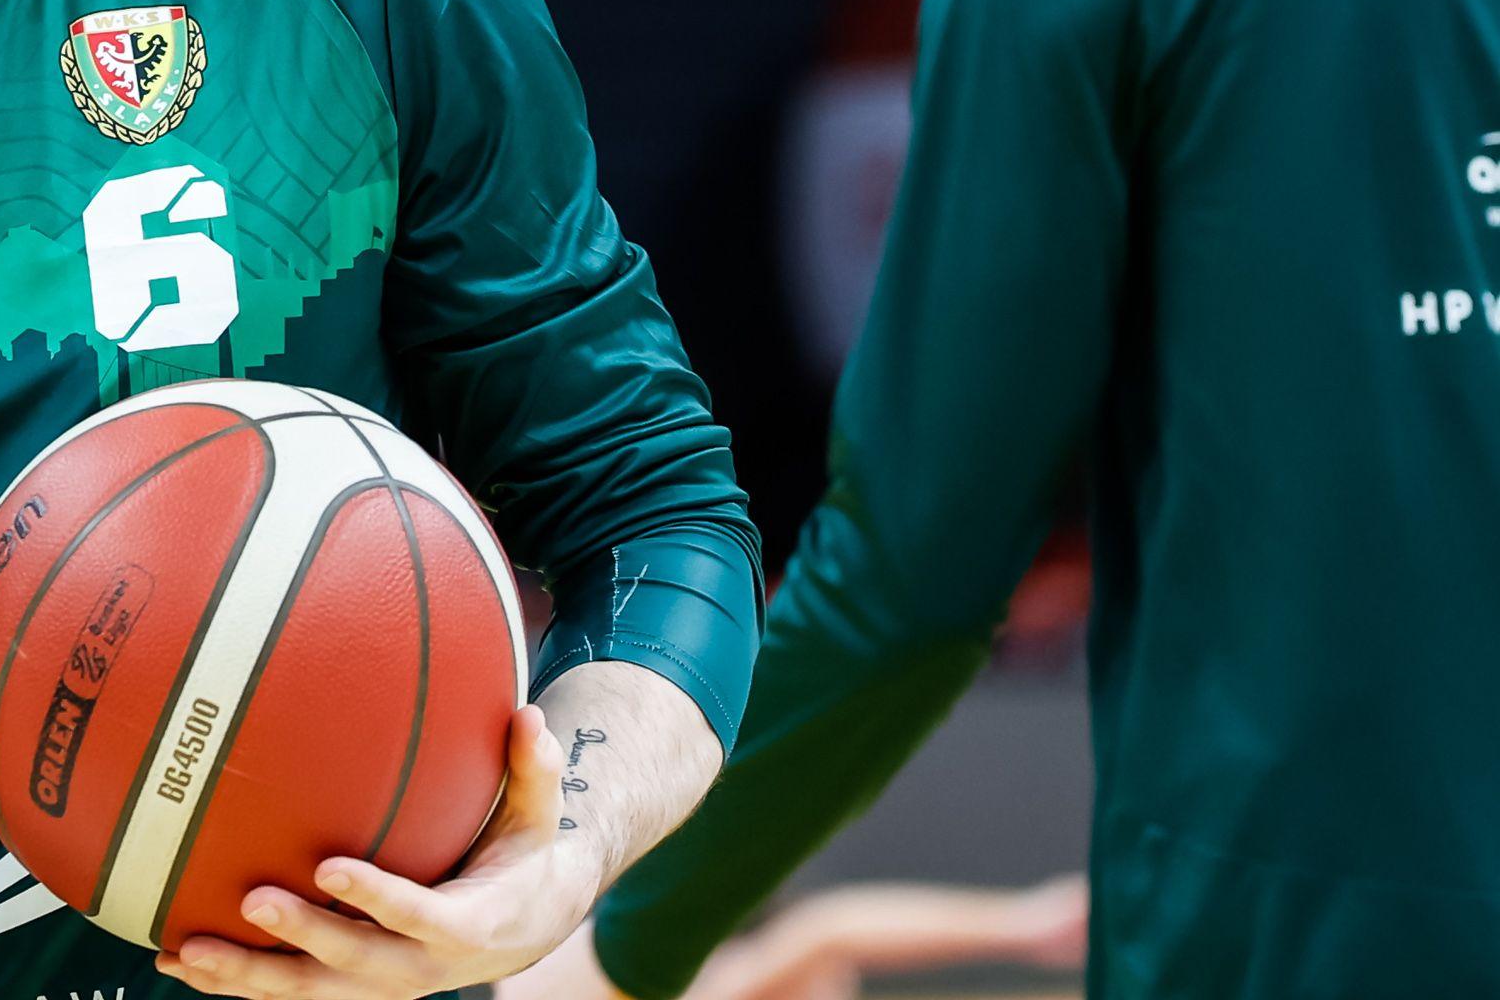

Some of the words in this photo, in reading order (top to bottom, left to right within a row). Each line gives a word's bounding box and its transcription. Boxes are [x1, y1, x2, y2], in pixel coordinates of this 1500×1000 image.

[82, 163, 240, 353] 6
[37, 698, 82, 806] ORLEN
[157, 698, 220, 804] BG4500
